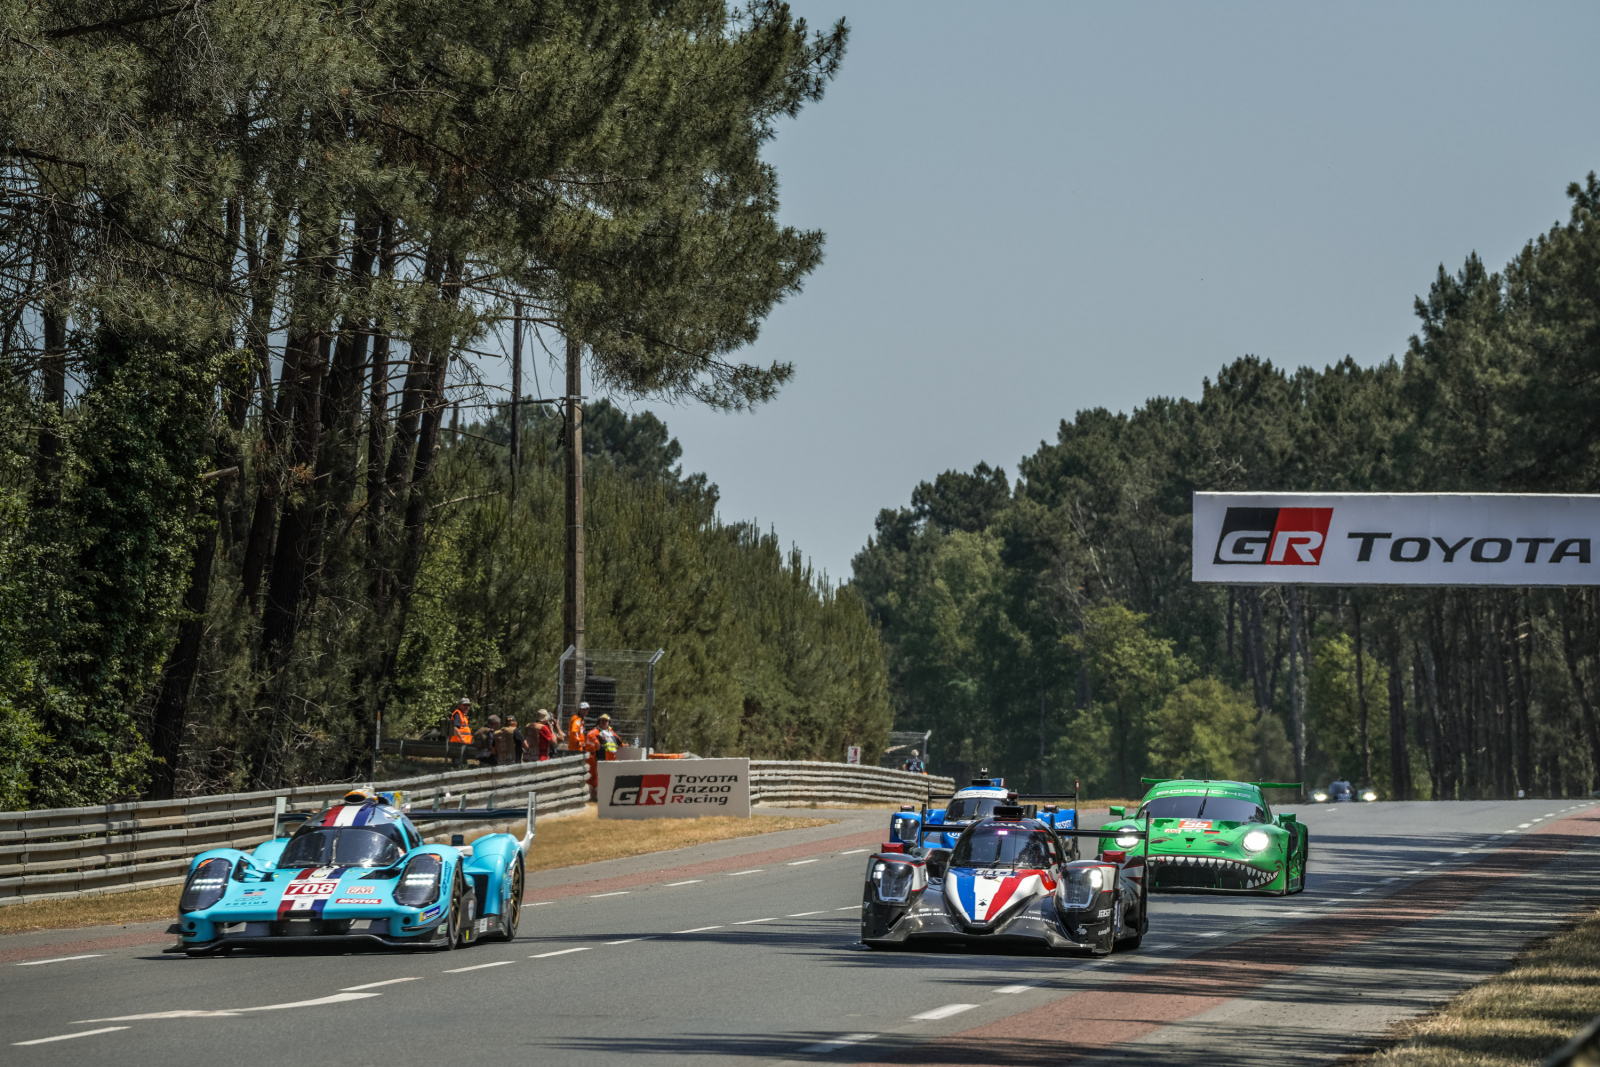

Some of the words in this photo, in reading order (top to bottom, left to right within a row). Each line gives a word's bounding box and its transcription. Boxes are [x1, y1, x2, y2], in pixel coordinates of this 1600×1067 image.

[1218, 530, 1323, 563] GR
[1347, 532, 1591, 563] TOYOTA
[674, 774, 738, 783] TOYOTA
[612, 786, 666, 805] GR
[670, 794, 728, 806] Racing
[1156, 789, 1252, 799] PORSCHE
[288, 883, 335, 895] 708
